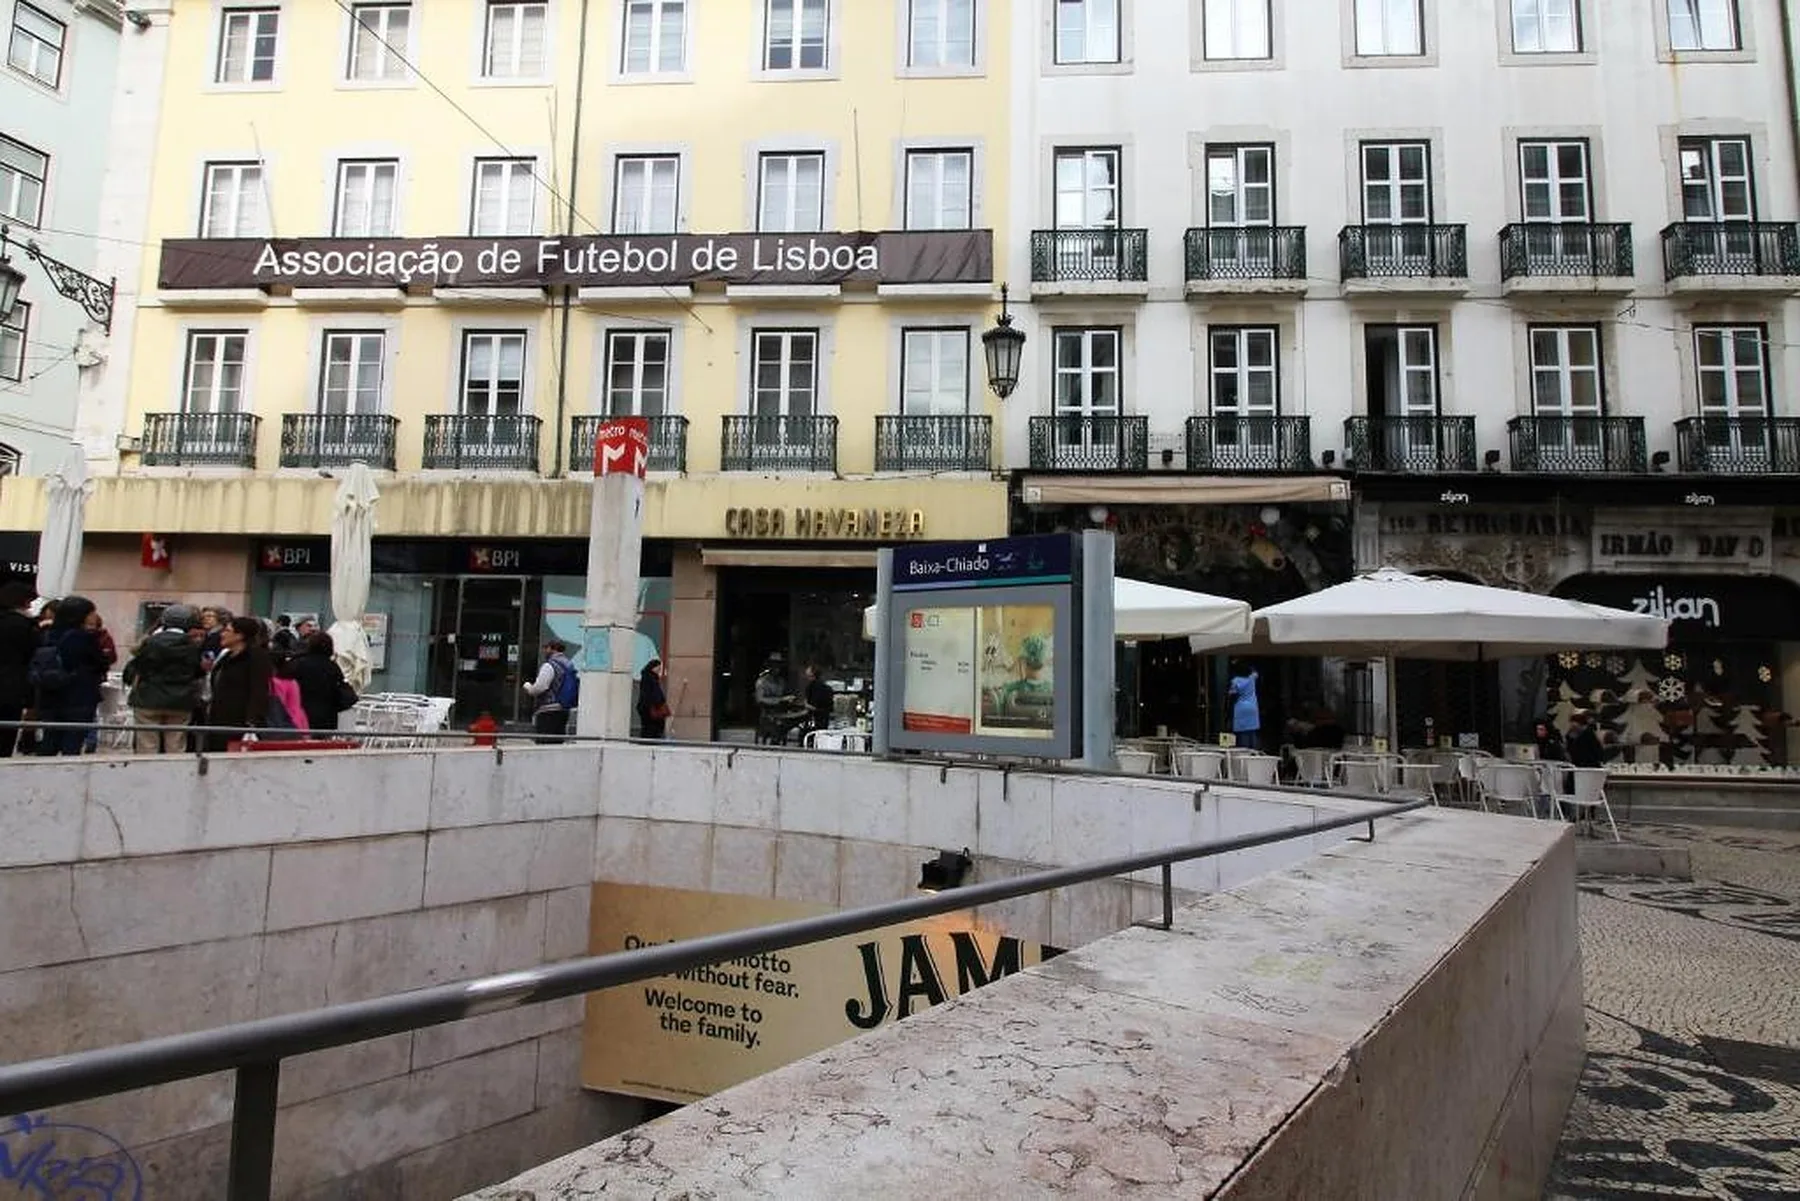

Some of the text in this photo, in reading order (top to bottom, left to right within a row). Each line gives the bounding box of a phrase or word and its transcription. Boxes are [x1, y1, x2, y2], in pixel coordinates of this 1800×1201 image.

[252, 238, 879, 283] Associação de Futebol de Lisboa
[725, 507, 925, 538] CASA HAVANEZA
[283, 547, 311, 565] BPI
[491, 550, 519, 568] BPI
[1600, 531, 1674, 556] IRMÃO
[909, 555, 990, 576] Baixa-Chiado
[1632, 585, 1720, 627] zilian
[754, 972, 800, 998] fear.
[846, 932, 1070, 1029] JAM
[644, 987, 763, 1024] Welcome to
[660, 1012, 761, 1048] the family.
